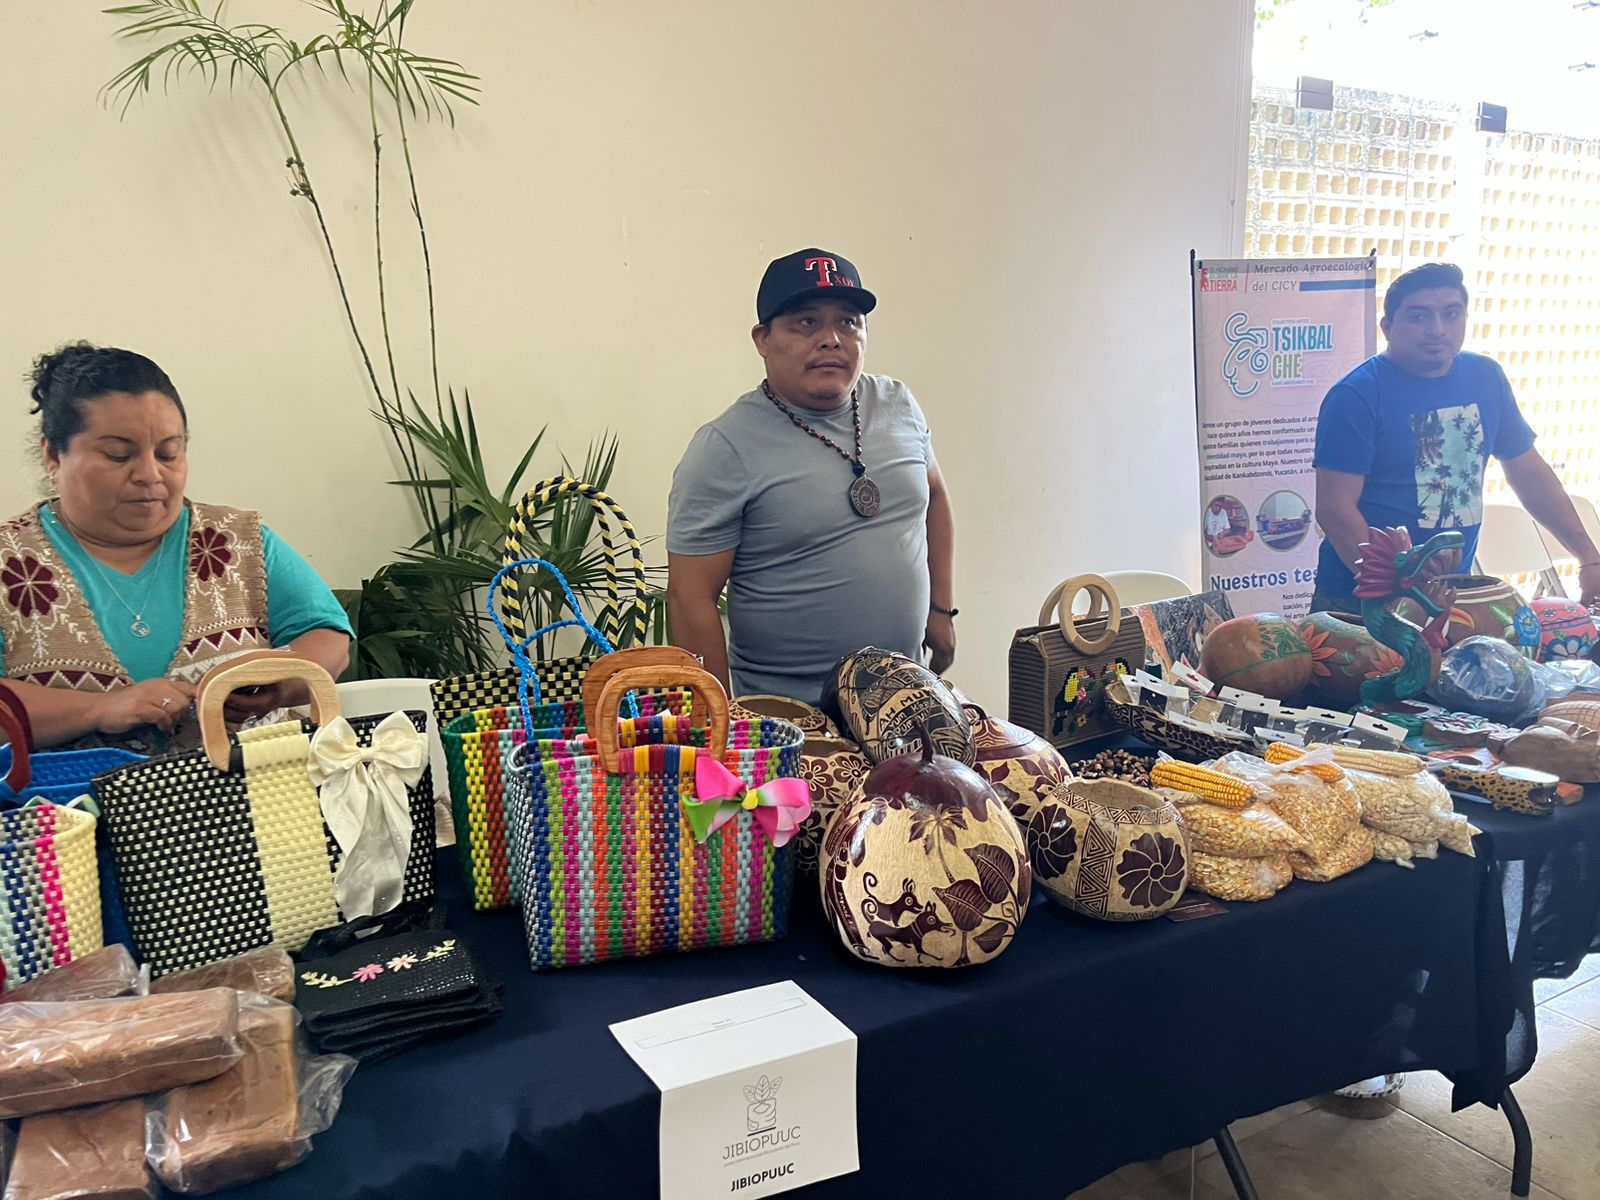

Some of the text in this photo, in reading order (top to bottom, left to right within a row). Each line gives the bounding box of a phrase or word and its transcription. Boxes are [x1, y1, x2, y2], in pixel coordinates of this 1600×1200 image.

[1254, 263, 1299, 274] Mercado
[1210, 279, 1238, 292] TIERRA
[1252, 280, 1297, 291] del CICY
[1272, 325, 1333, 352] TSIKBAL
[1273, 353, 1302, 379] CHE
[1224, 421, 1241, 429] grupo
[1250, 418, 1271, 427] jóvenes
[1218, 431, 1236, 439] quince
[1272, 427, 1306, 435] conformado
[1240, 440, 1261, 448] quienes
[1263, 438, 1295, 446] trabajamos
[1242, 460, 1261, 468] cultura
[1211, 571, 1287, 591] Nuestros
[722, 1125, 801, 1160] JIBIOPUUC
[730, 1162, 794, 1192] JIBIOPUUC
